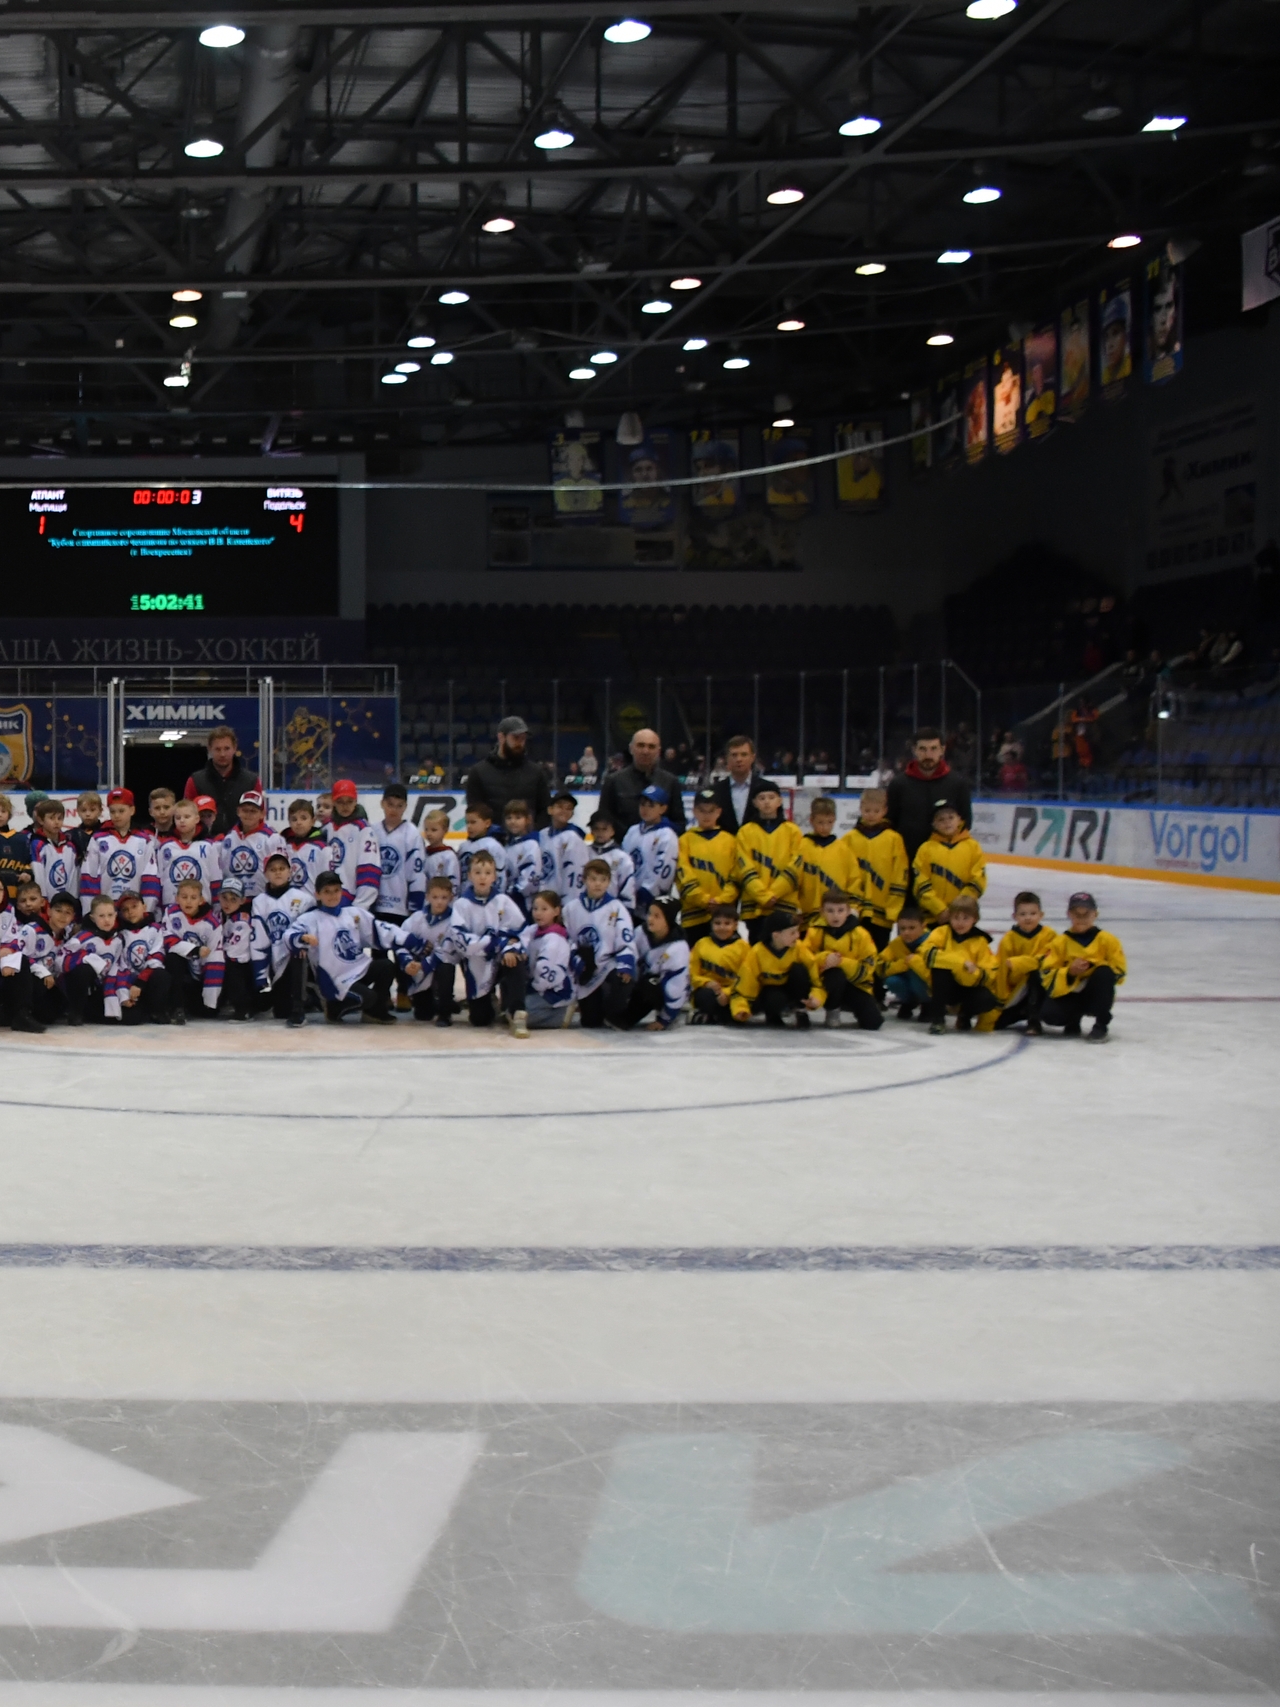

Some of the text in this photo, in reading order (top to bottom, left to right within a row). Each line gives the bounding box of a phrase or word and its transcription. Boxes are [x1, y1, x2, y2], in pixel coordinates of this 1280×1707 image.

[31, 489, 66, 500] АТЛАНТ
[28, 502, 68, 513] Мытищи
[263, 500, 307, 512] Подольск
[37, 514, 47, 535] 1
[289, 513, 304, 533] 4
[129, 593, 205, 611] 15:02:41
[126, 704, 226, 720] ХИМИК
[409, 775, 441, 784] PARI
[564, 775, 597, 784] PARI
[1008, 806, 1111, 862] PARI
[1149, 811, 1250, 872] Vorgol
[653, 859, 671, 880] 20
[540, 966, 557, 983] 26
